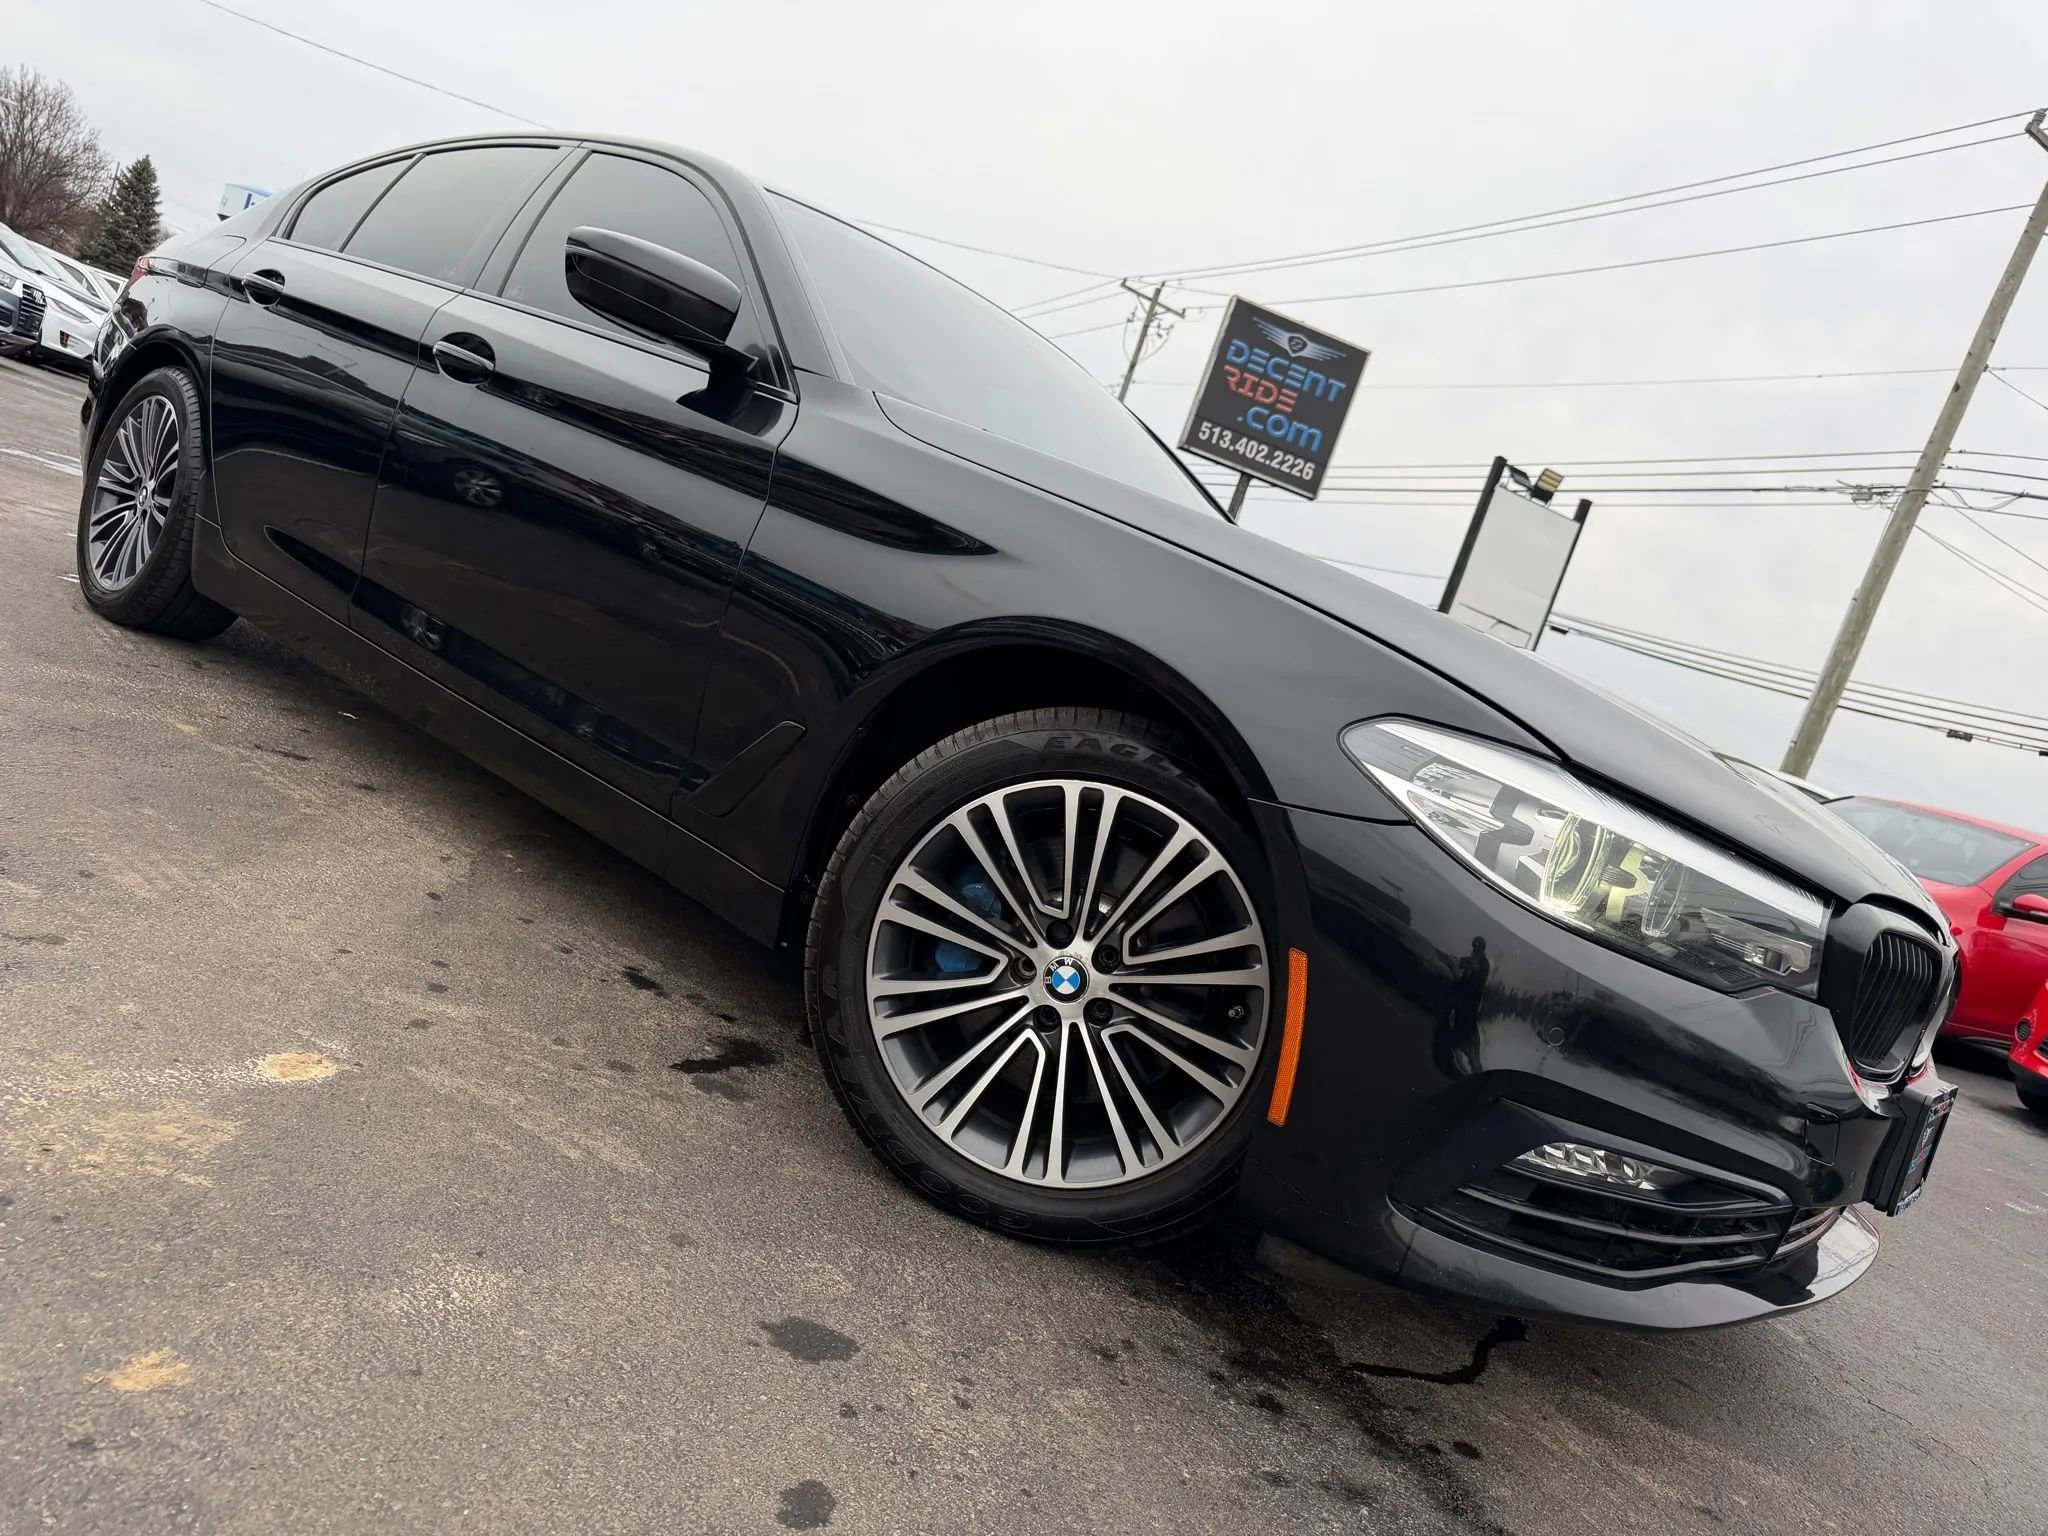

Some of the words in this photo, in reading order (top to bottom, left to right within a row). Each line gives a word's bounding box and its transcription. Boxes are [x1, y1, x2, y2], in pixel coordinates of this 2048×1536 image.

[1224, 365, 1299, 413] RIDE
[1225, 339, 1346, 401] DECENT
[1198, 421, 1316, 481] 513.402.2226
[1044, 958, 1074, 985] BMW
